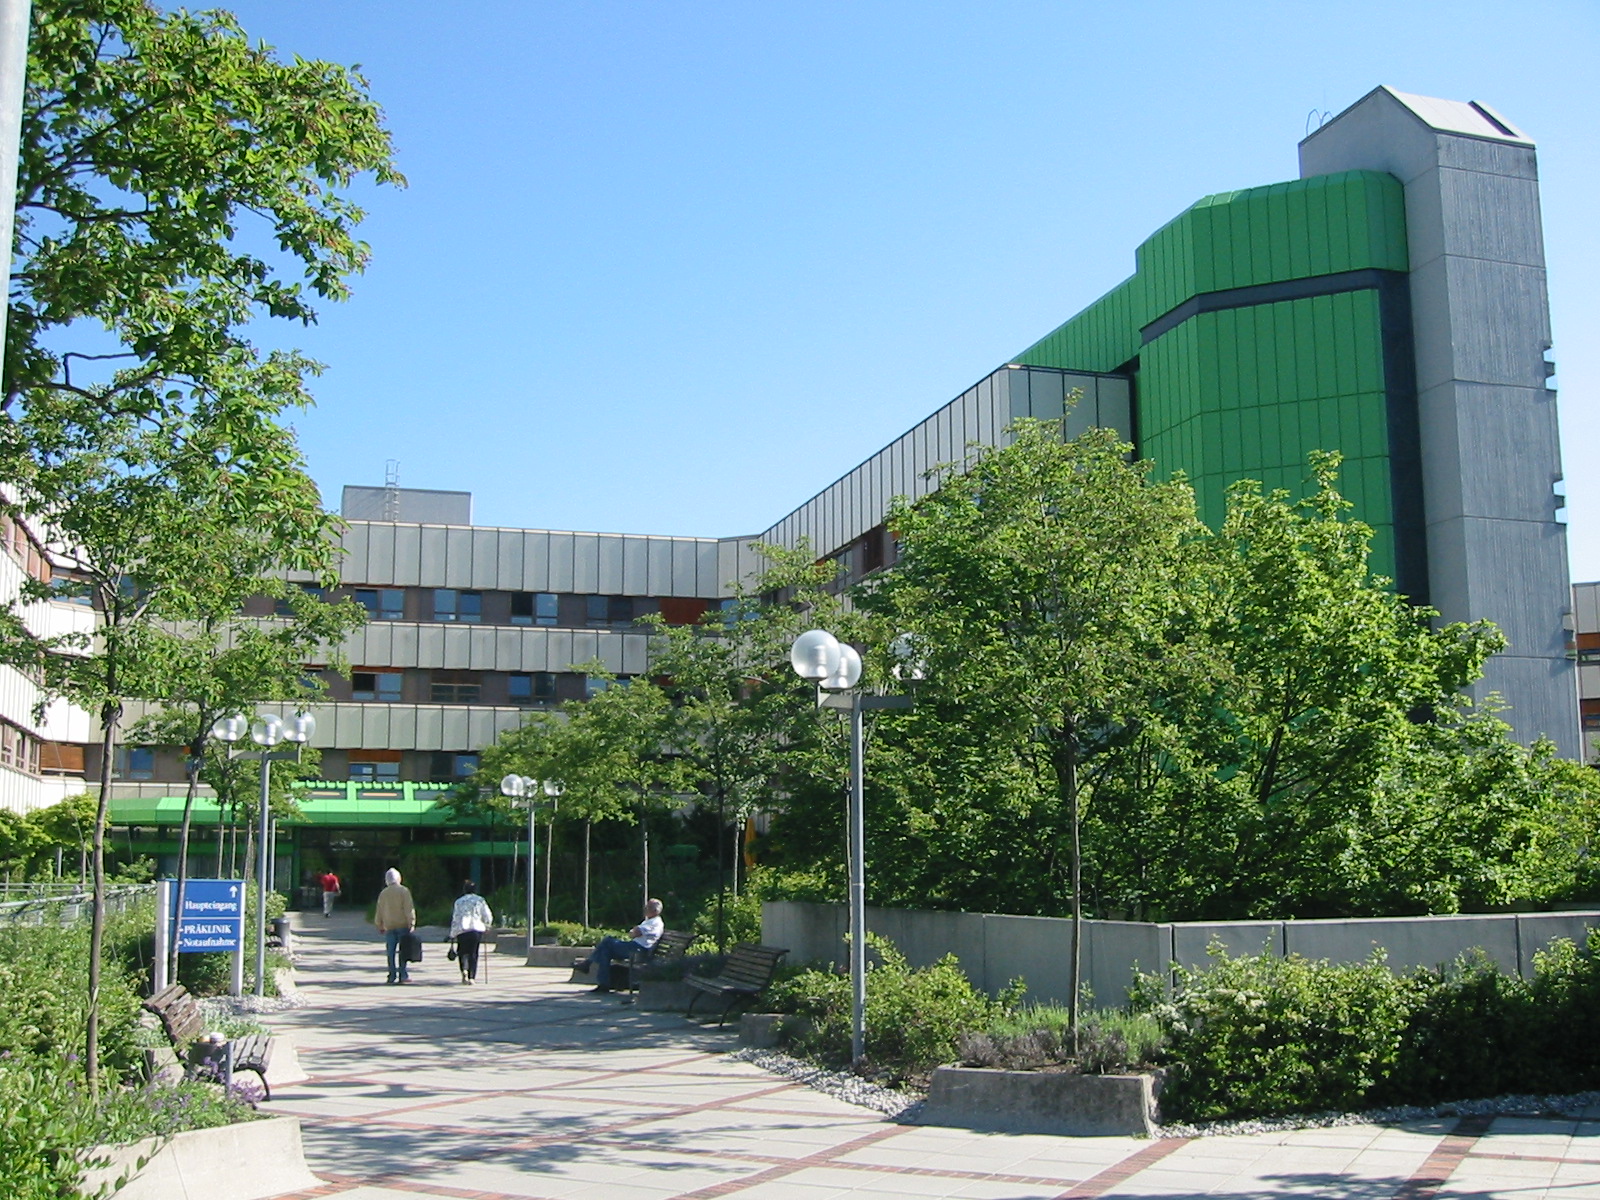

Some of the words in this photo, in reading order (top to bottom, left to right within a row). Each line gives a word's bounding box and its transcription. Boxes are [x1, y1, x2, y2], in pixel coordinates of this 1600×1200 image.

[184, 900, 238, 912] Haupteingang
[184, 923, 232, 934] PRÄKLINIK
[183, 936, 237, 947] Notaufnahme
